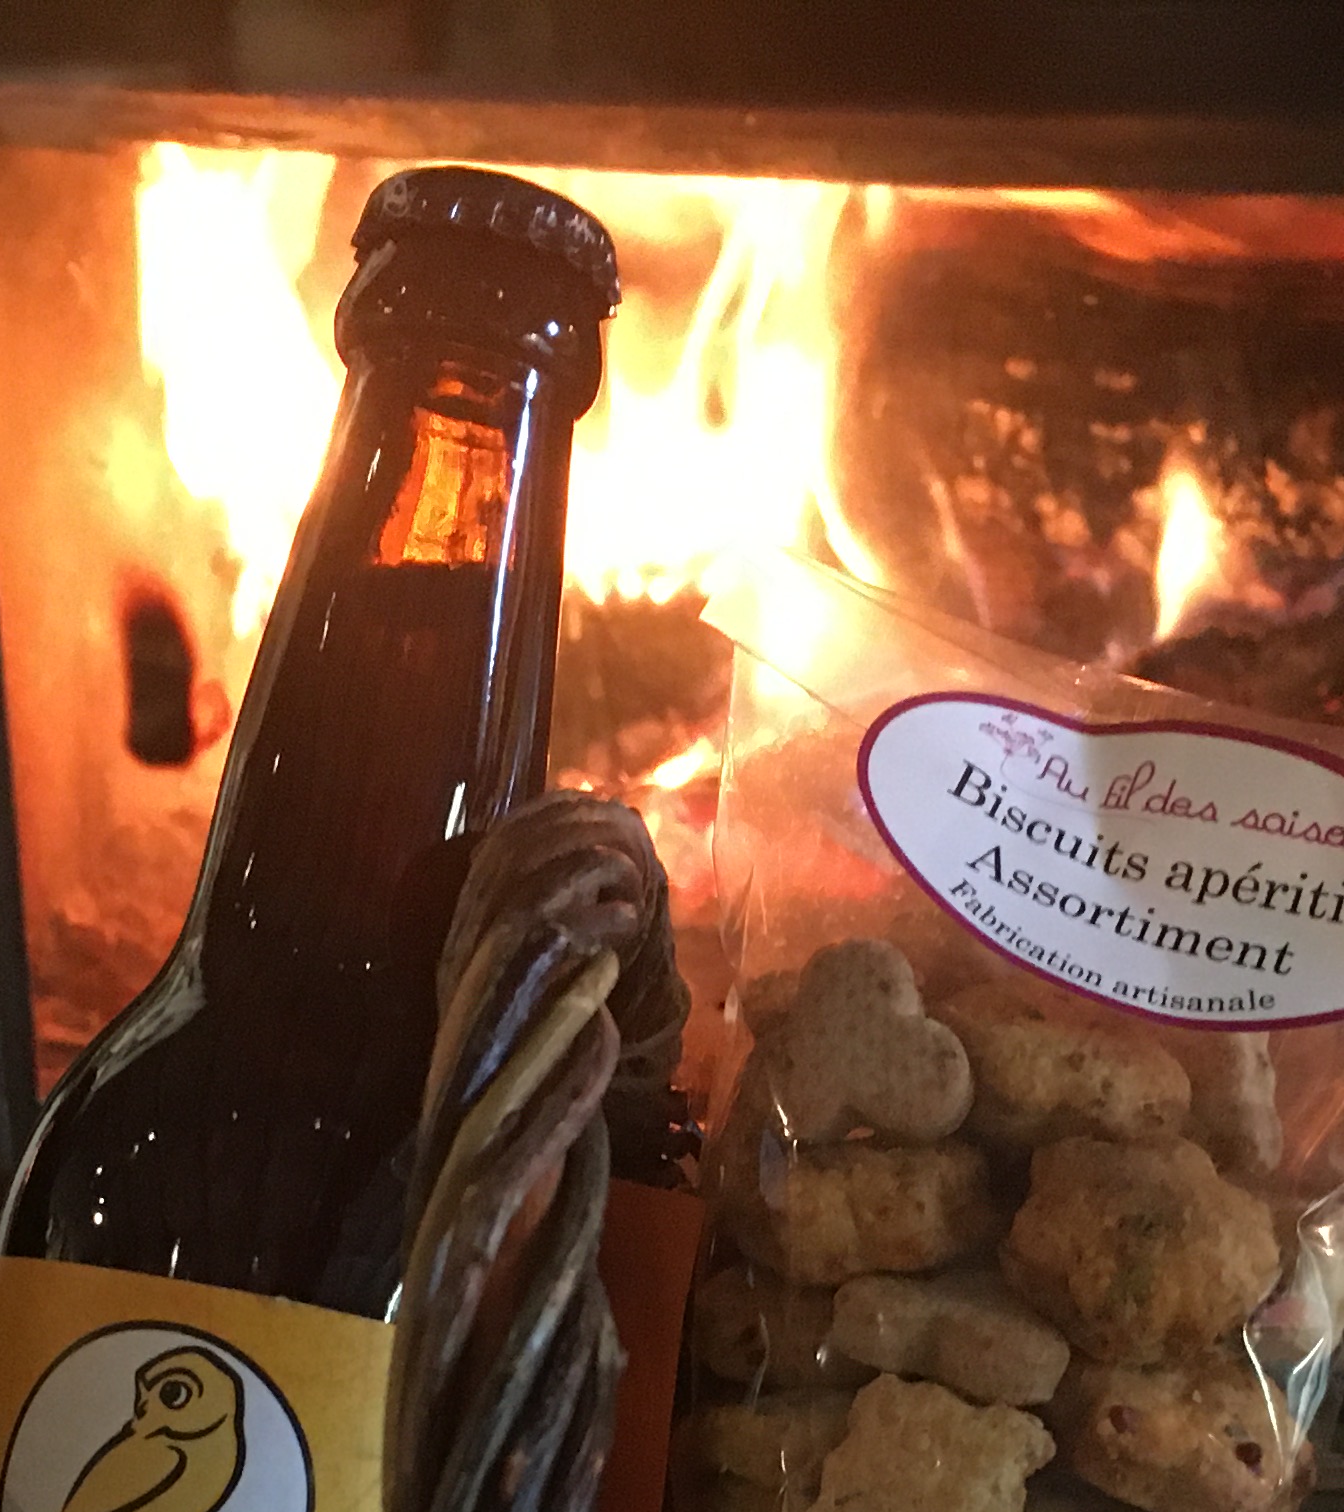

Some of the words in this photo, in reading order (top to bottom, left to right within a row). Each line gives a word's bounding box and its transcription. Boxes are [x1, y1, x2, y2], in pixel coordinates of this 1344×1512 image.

[947, 760, 1151, 882] Biscuits
[1036, 755, 1090, 803] Au
[1144, 778, 1218, 823] des
[948, 878, 1104, 989] Fabrication
[1112, 979, 1277, 1015] artisanale
[965, 842, 1296, 977] Assortiment
